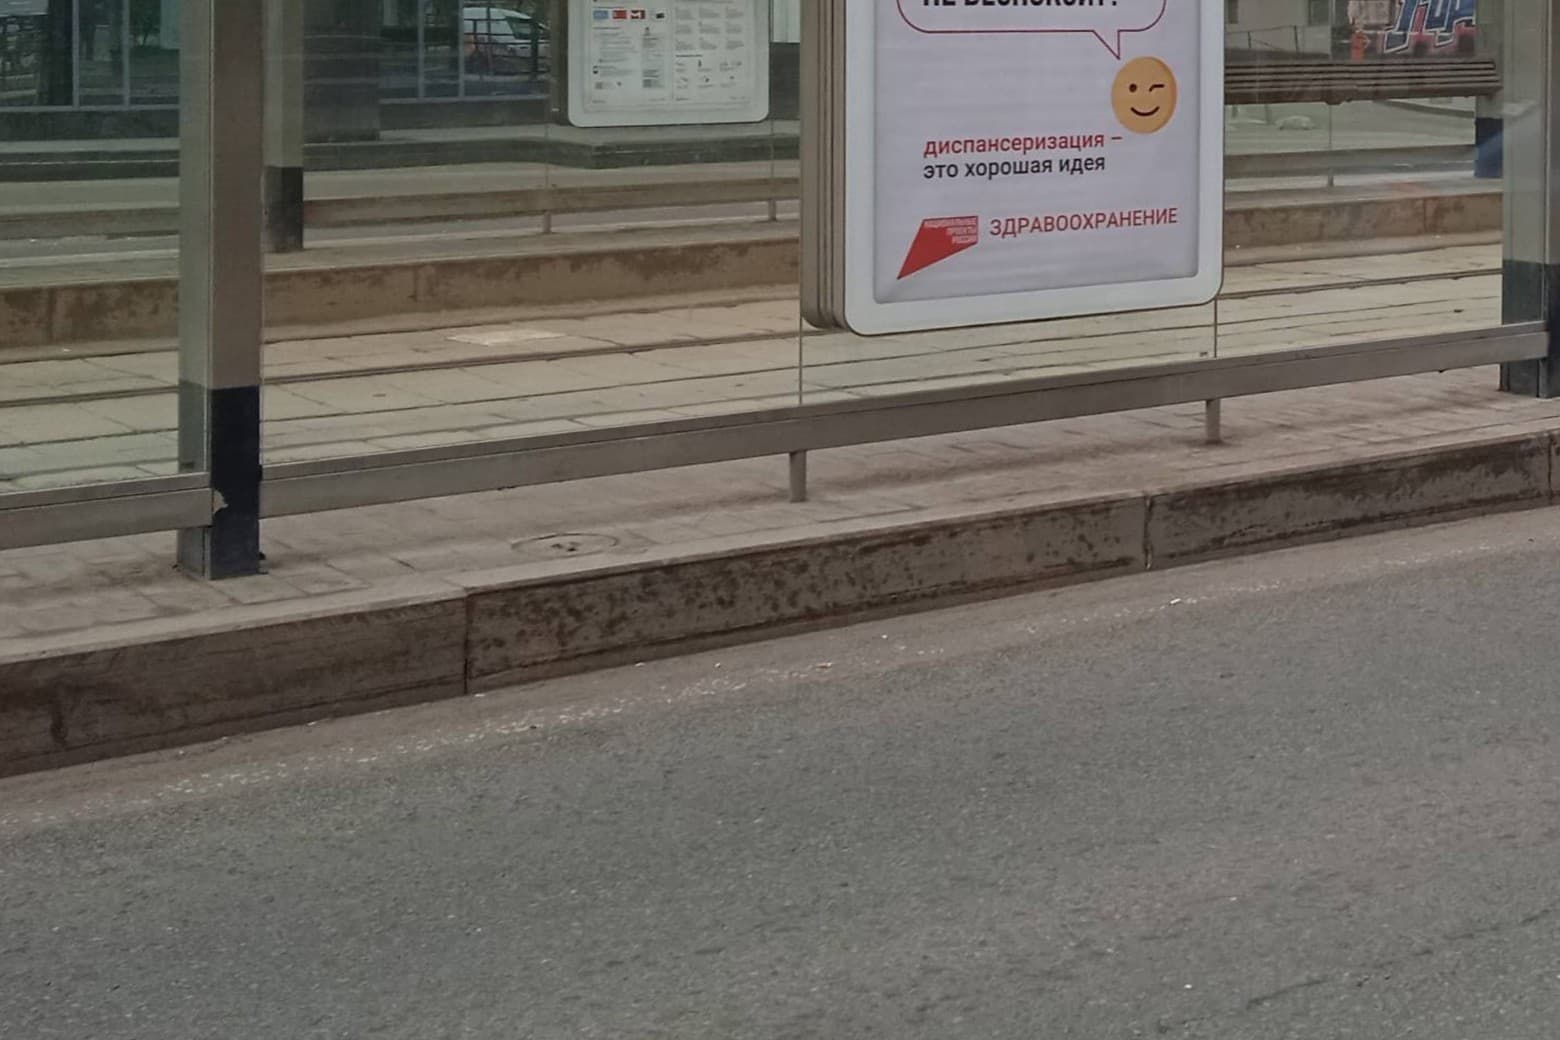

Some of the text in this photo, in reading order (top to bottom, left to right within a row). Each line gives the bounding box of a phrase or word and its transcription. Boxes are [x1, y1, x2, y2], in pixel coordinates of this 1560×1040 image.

[922, 133, 1105, 159] диспансеризация
[923, 156, 1106, 181] это хорошая идея
[989, 207, 1179, 240] ЗДРАВООХРАНЕНИЕ
